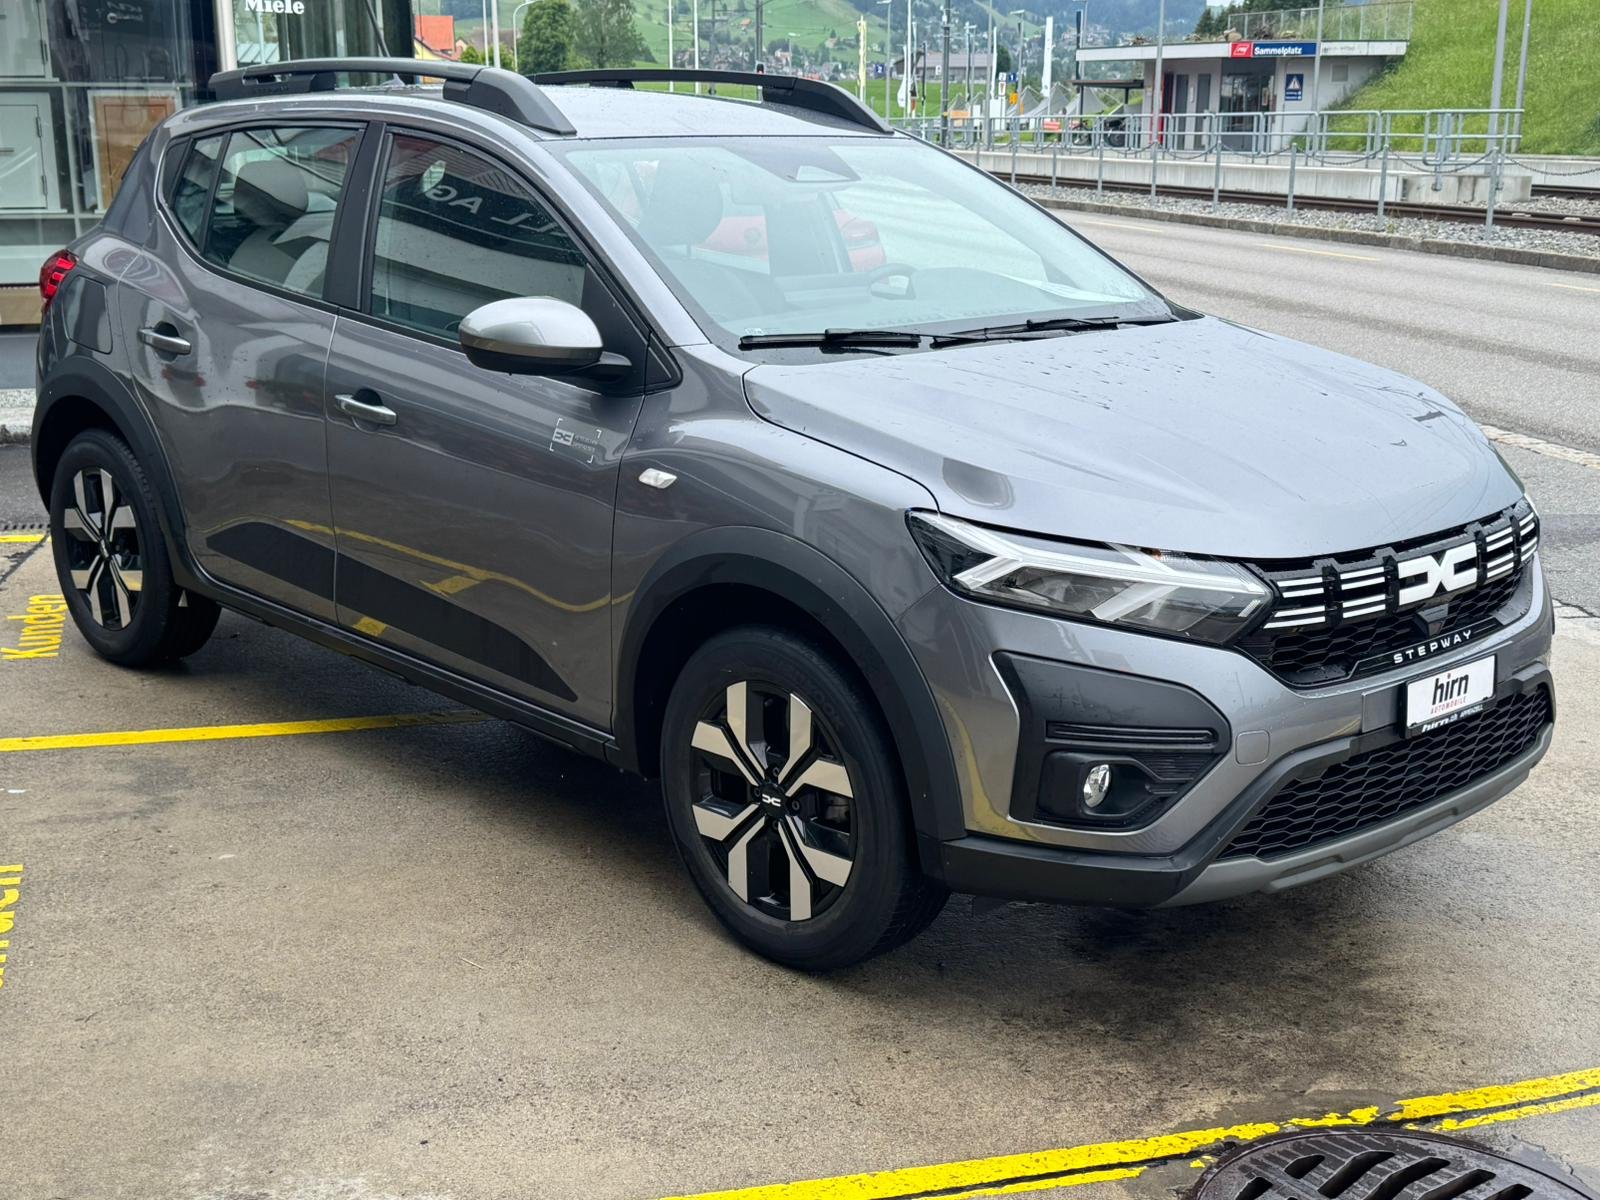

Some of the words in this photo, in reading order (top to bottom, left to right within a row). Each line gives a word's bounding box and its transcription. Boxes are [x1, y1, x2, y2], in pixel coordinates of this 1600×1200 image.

[245, 0, 305, 14] Miele
[1254, 46, 1302, 56] Sammelplatz
[0, 594, 67, 659] Kunden
[1393, 630, 1471, 664] STEPWAY
[1432, 673, 1469, 706] hirn
[1430, 696, 1467, 714] AUTOMOBILE
